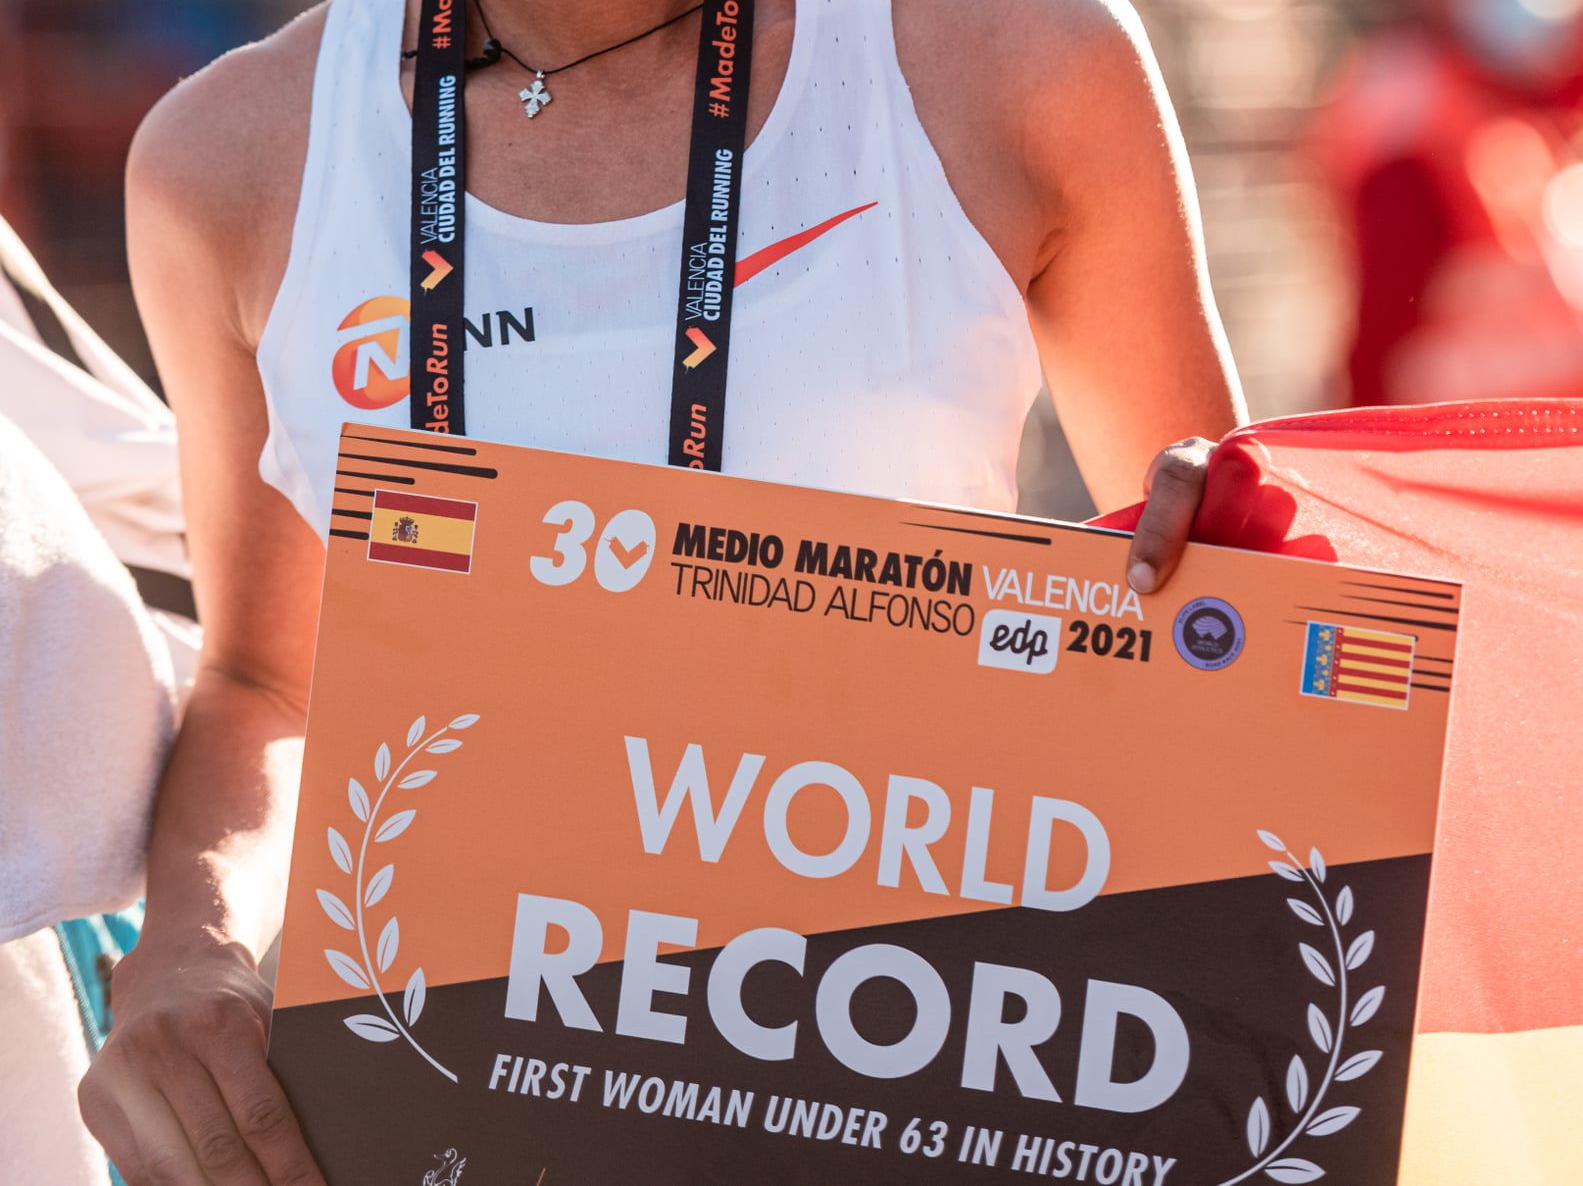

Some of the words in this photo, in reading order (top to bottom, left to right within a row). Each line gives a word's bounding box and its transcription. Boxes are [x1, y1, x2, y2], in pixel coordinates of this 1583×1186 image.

[438, 75, 456, 145] RUNNING
[438, 147, 456, 178] DEL
[711, 148, 734, 222] RUNNING
[420, 167, 438, 245] VALENCIA
[438, 180, 456, 243] CIUDAD
[709, 225, 728, 255] DEL
[685, 242, 708, 321] VALENCIA
[703, 257, 724, 321] CIUDAD
[530, 500, 656, 592] 30
[672, 522, 784, 569] MEDIO
[794, 540, 973, 596] MARATÓN
[671, 562, 816, 613] TRINIDAD
[824, 586, 975, 636] ALFONSO
[982, 565, 1144, 621] VALENCIA
[989, 619, 1048, 665] edp
[1066, 620, 1152, 662] 2021
[624, 736, 1111, 912] WORLD
[504, 893, 1190, 1113] RECORD
[488, 1054, 592, 1102] FIRST
[603, 1070, 754, 1128] WOMAN
[763, 1095, 888, 1149] UNDER
[900, 1117, 948, 1158] 63
[958, 1126, 1003, 1167] IN
[1011, 1133, 1178, 1186] HISTORY
